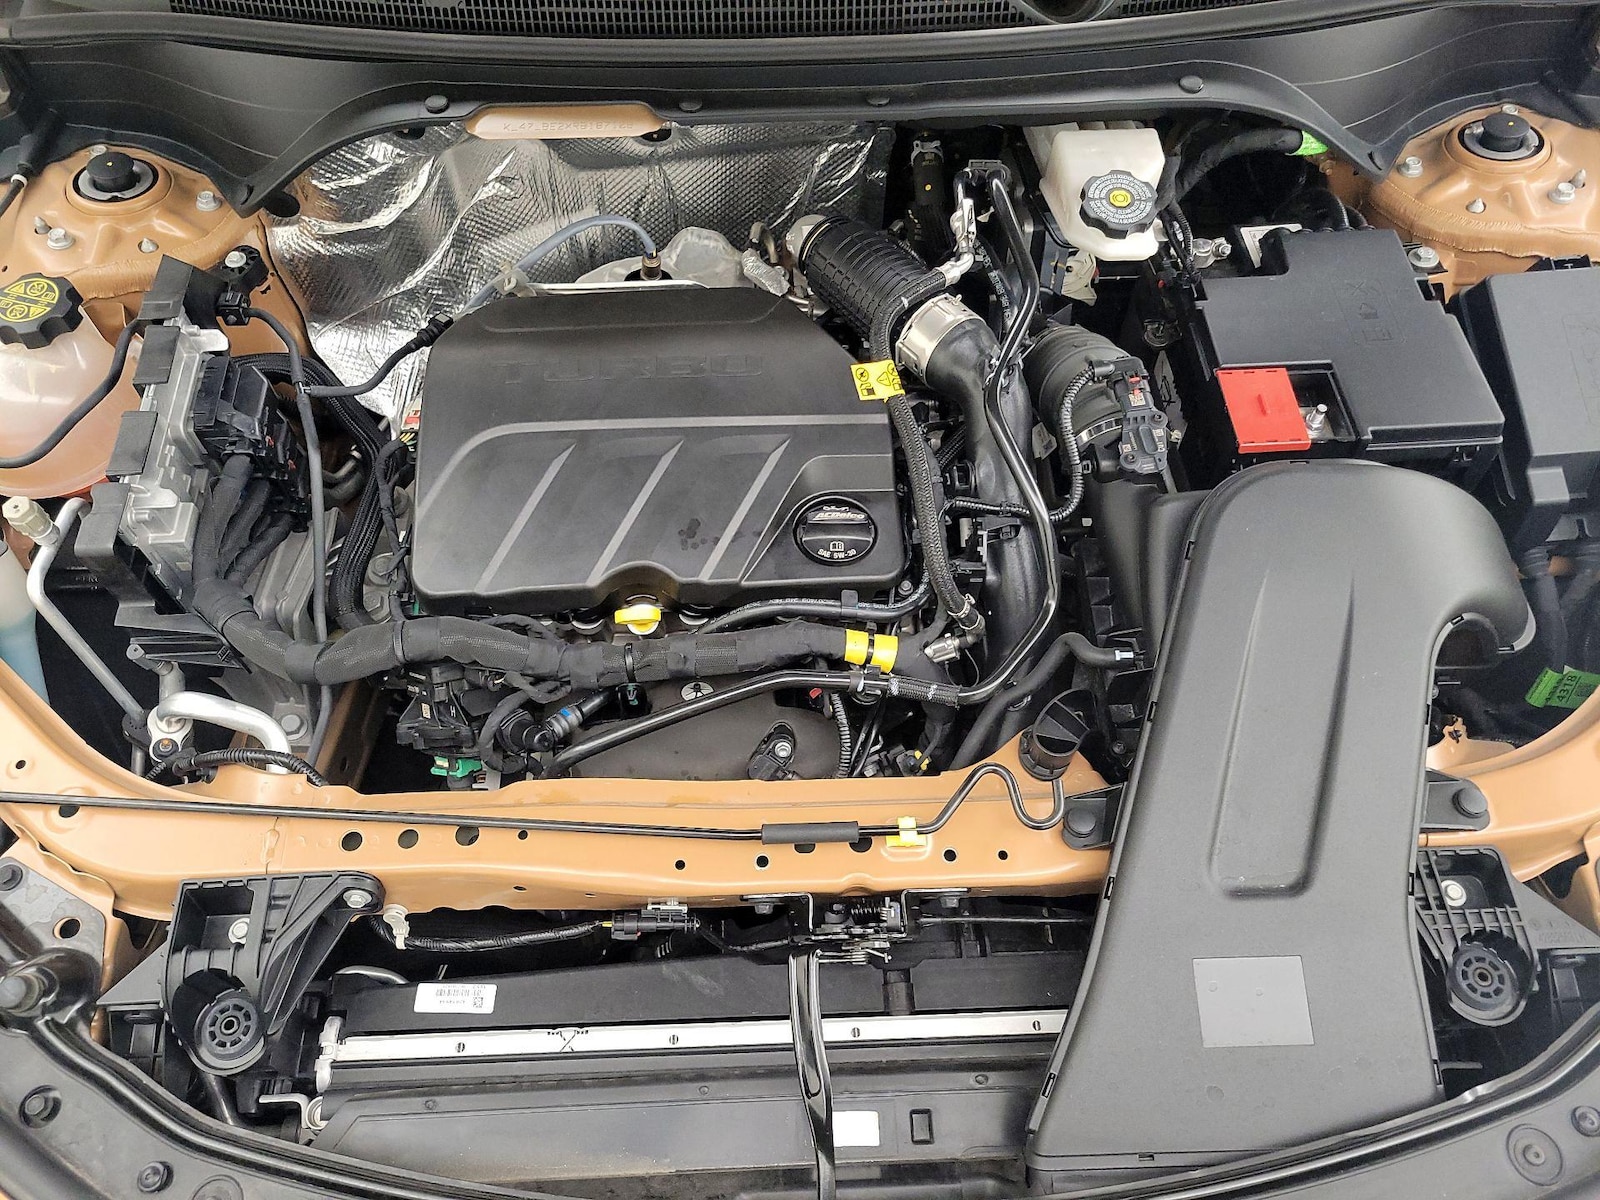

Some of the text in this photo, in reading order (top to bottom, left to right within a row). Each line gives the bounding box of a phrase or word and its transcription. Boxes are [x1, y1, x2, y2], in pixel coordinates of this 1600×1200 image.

[493, 354, 763, 384] TURBO
[812, 512, 865, 520] ACDelco
[817, 548, 832, 558] SAE
[1556, 675, 1577, 702] 4318
